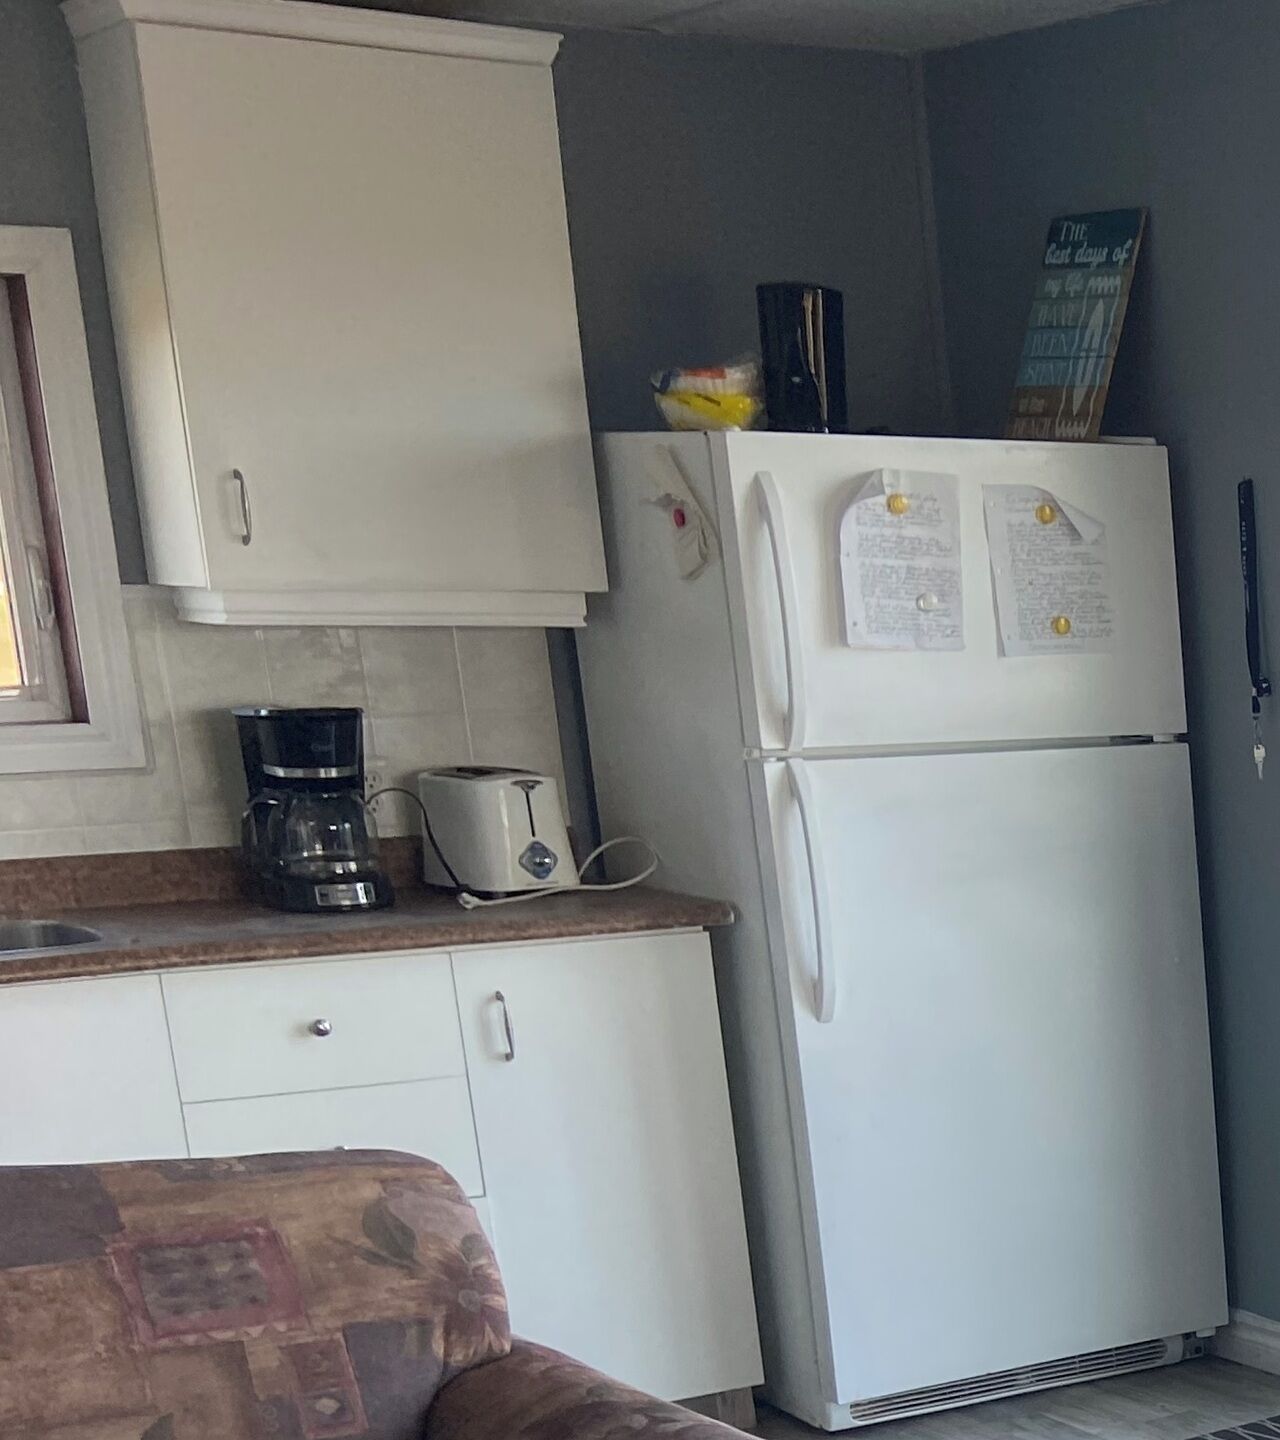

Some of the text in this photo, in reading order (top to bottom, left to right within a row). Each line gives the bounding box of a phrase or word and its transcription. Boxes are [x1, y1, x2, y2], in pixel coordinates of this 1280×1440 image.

[1060, 221, 1089, 242] THE
[1044, 238, 1133, 270] best days of
